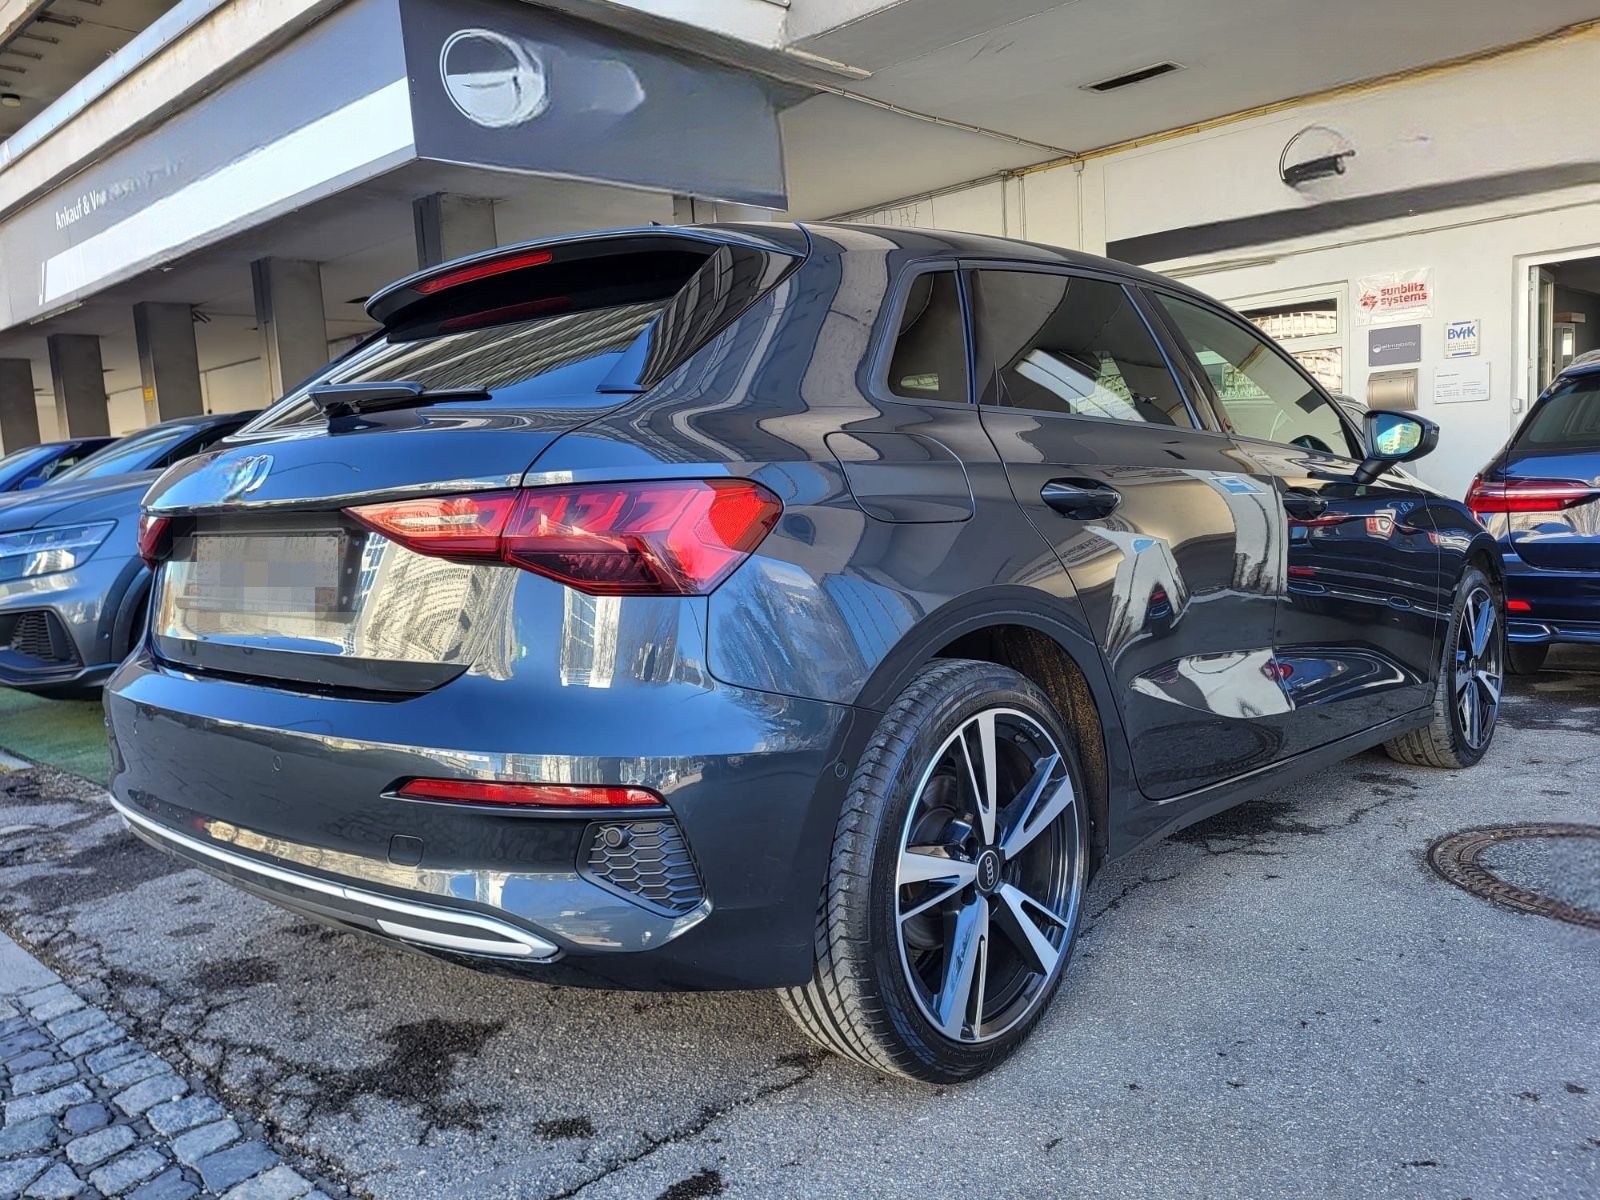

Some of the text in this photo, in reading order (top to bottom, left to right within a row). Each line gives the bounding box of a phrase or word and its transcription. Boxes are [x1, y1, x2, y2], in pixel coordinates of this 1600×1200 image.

[55, 195, 90, 231] Ankauf &
[1381, 282, 1424, 296] sunblitz
[1381, 292, 1427, 306] systems
